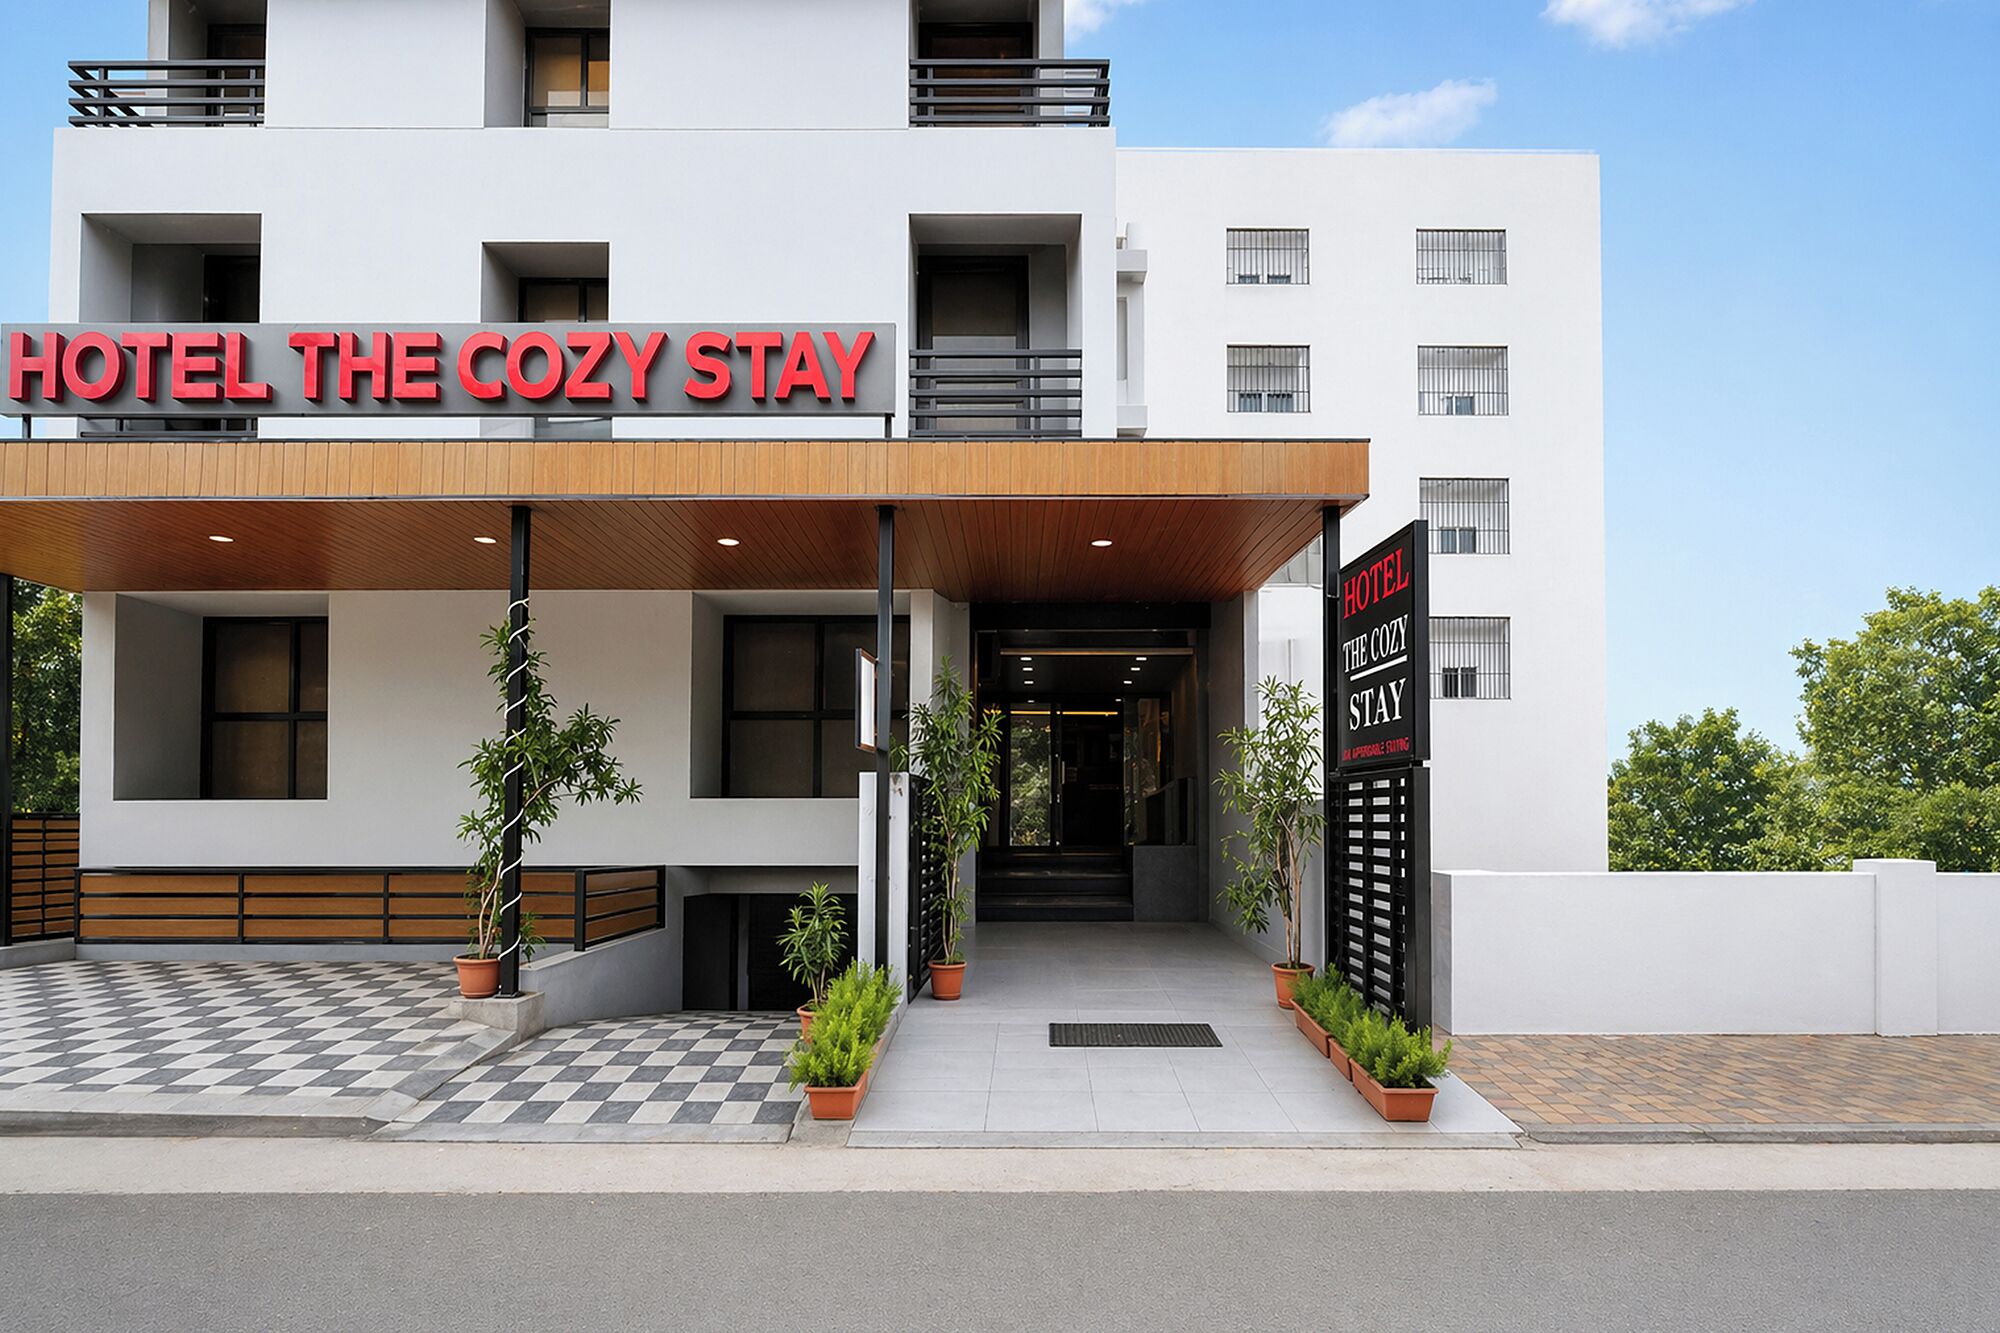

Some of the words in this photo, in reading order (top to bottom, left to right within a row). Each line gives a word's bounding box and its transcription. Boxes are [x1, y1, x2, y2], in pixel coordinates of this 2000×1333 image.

[8, 331, 273, 401] HOTEL
[289, 332, 443, 401] THE
[457, 331, 669, 401] COZY
[683, 331, 876, 401] STAY
[1344, 548, 1409, 619] HOTEL
[1342, 633, 1368, 673] THE
[1370, 614, 1409, 661] COZY
[1349, 678, 1407, 731] STAY
